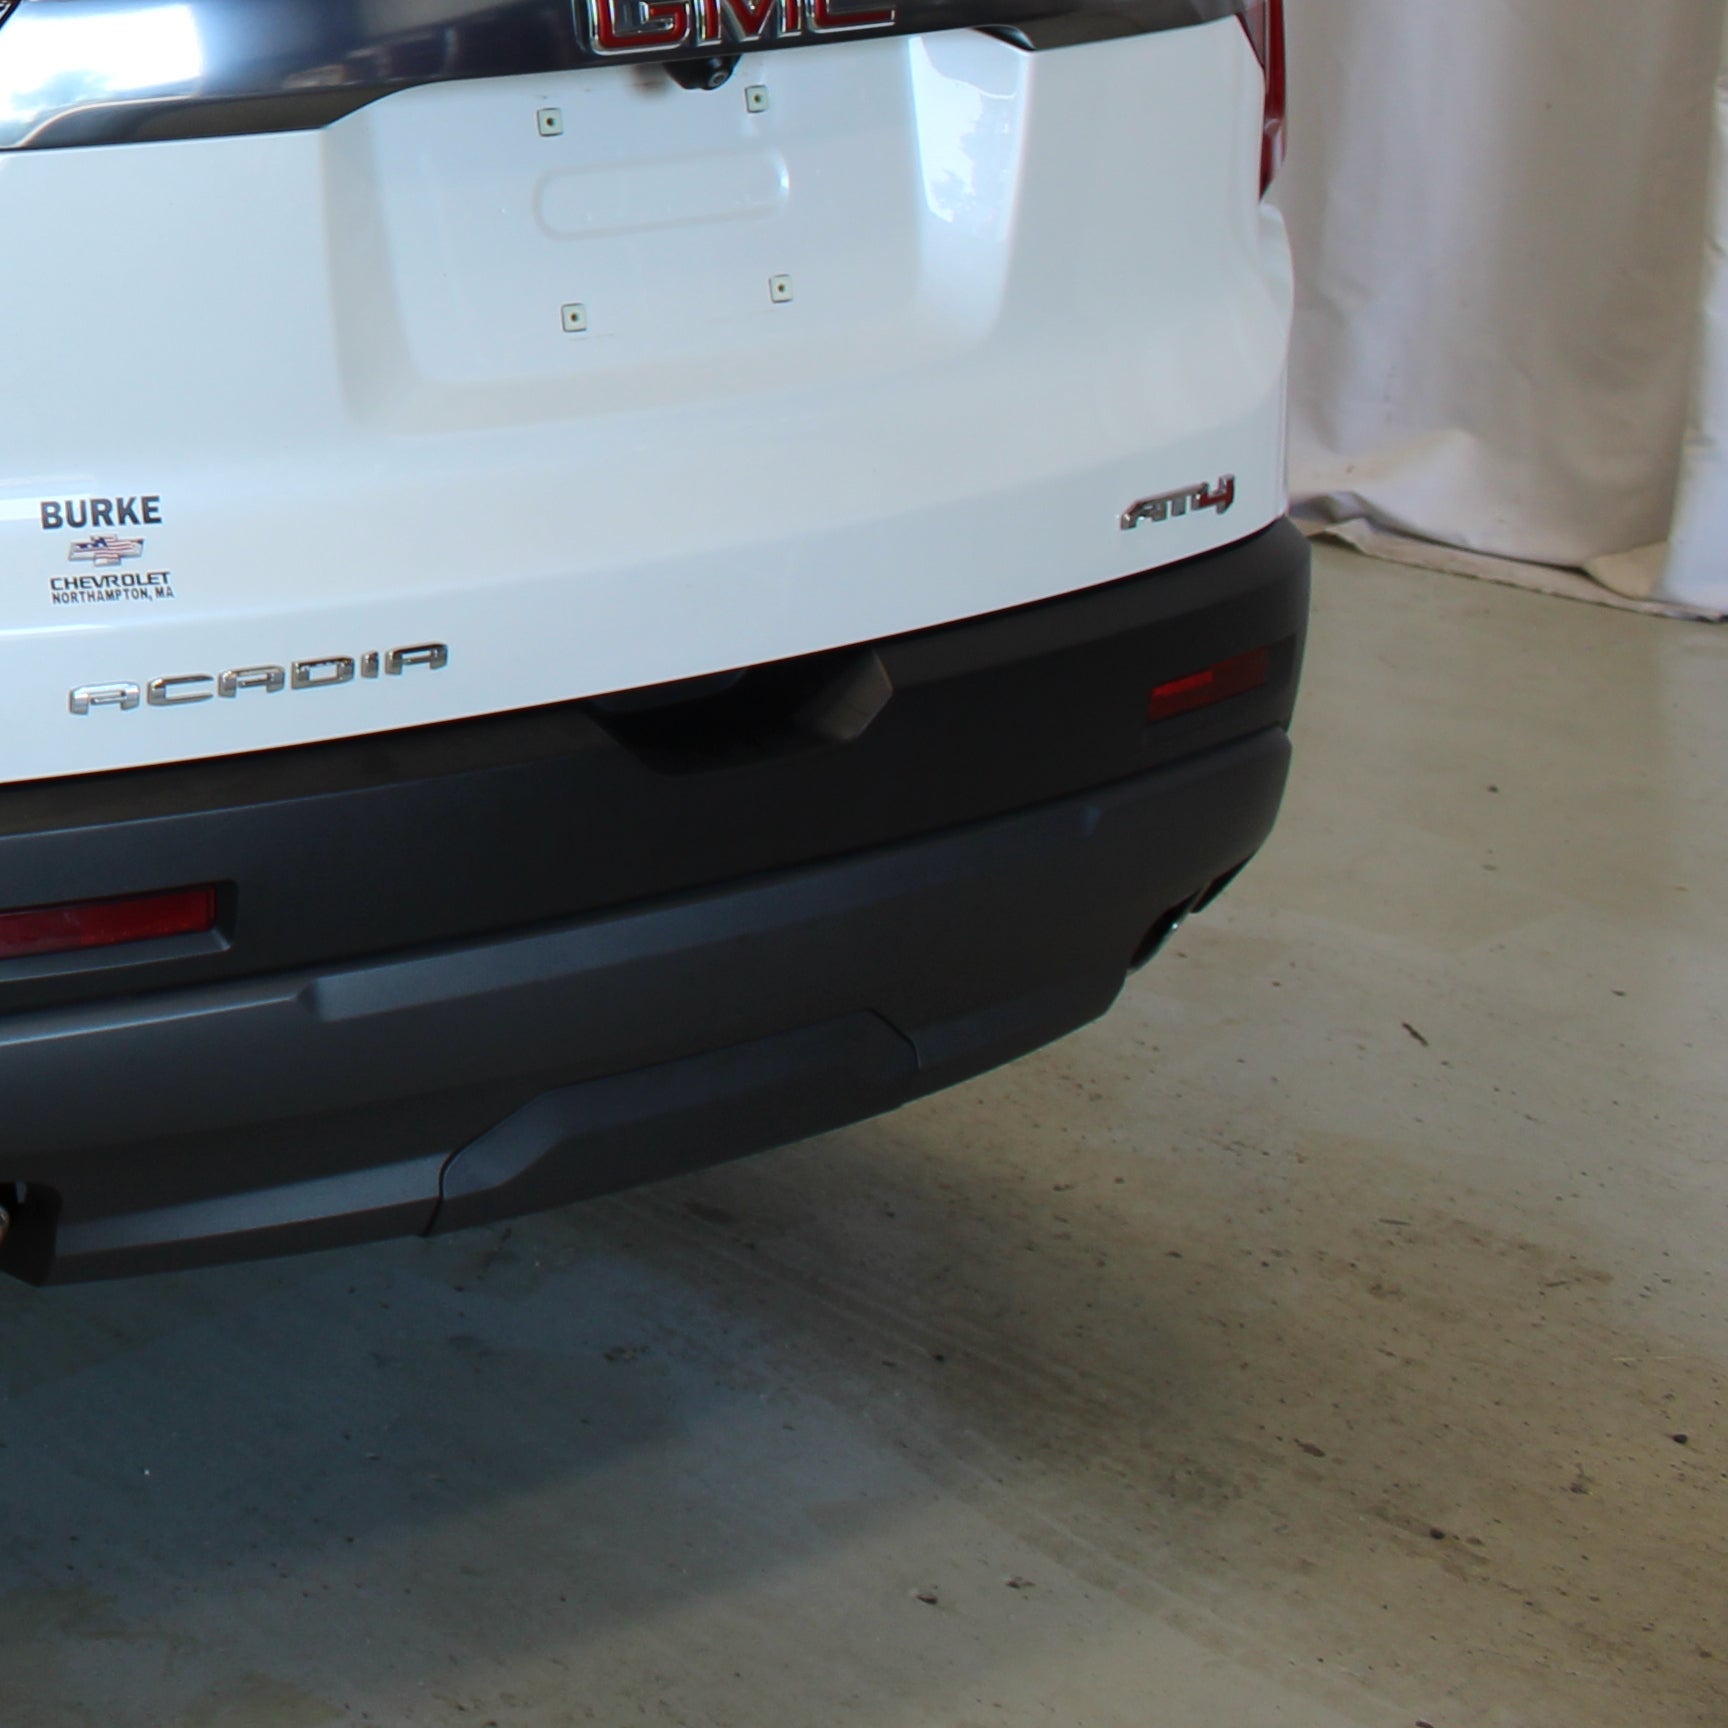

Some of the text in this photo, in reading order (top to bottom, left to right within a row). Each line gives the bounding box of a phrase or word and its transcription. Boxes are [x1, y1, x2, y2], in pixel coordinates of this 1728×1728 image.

[40, 495, 163, 530] BURKE
[1120, 473, 1235, 530] AT4
[50, 571, 171, 591] CHEVROLET
[52, 586, 175, 604] NORTHAMPTON, MA
[69, 641, 448, 715] ACADIA
